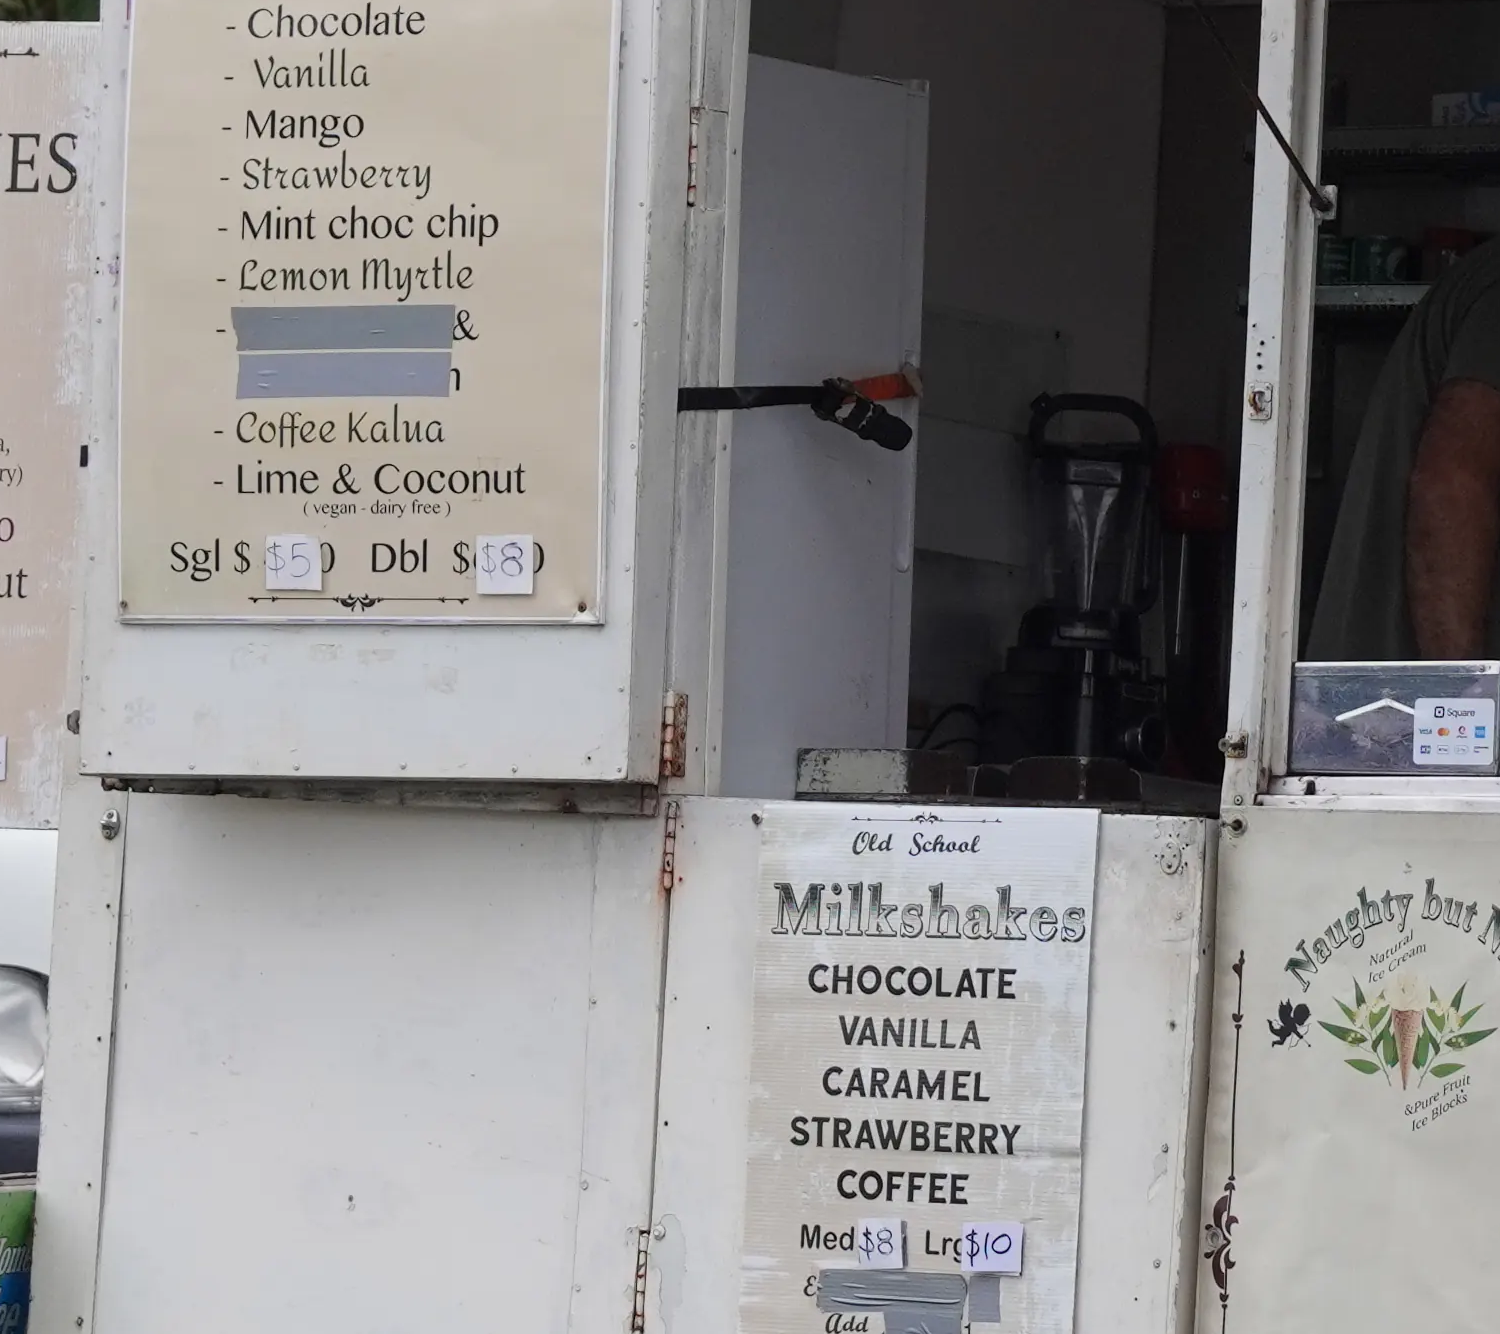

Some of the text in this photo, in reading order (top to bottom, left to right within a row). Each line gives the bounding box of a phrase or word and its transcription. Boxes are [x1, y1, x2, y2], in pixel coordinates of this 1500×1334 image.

[248, 3, 426, 37] Chocolate
[253, 50, 370, 89] Vanilla
[245, 109, 365, 146] Mango
[242, 157, 432, 198] Strawberry
[240, 204, 499, 246] Mint choc chip
[239, 257, 474, 302] Lemon Myrtle
[236, 404, 444, 443] Coffee Kalua
[236, 463, 525, 495] Lime & Coconut
[371, 500, 406, 517] dairy
[170, 538, 220, 581] Sgl
[267, 541, 311, 578] $5
[372, 539, 427, 573] Dbl
[482, 541, 524, 576] $8
[1447, 708, 1475, 717] Square
[852, 831, 980, 856] Old School
[771, 882, 1086, 943] Milkshakes
[1285, 886, 1414, 993] Naughty
[1421, 878, 1478, 933] but
[1369, 929, 1414, 966] Natural
[808, 963, 1017, 1000] CHOCOLATE
[1368, 944, 1427, 984] Ice Cream
[838, 1016, 981, 1050] VANILLA
[822, 1066, 990, 1103] CARAMEL
[1443, 1074, 1471, 1097] Fruit
[1411, 1093, 1468, 1131] Ice Blocks
[791, 1117, 1021, 1156] STRAWBERRY
[837, 1170, 969, 1204] COFFEE
[801, 1224, 894, 1261] Med $8
[965, 1229, 1012, 1266] $10
[825, 1313, 868, 1334] Add
